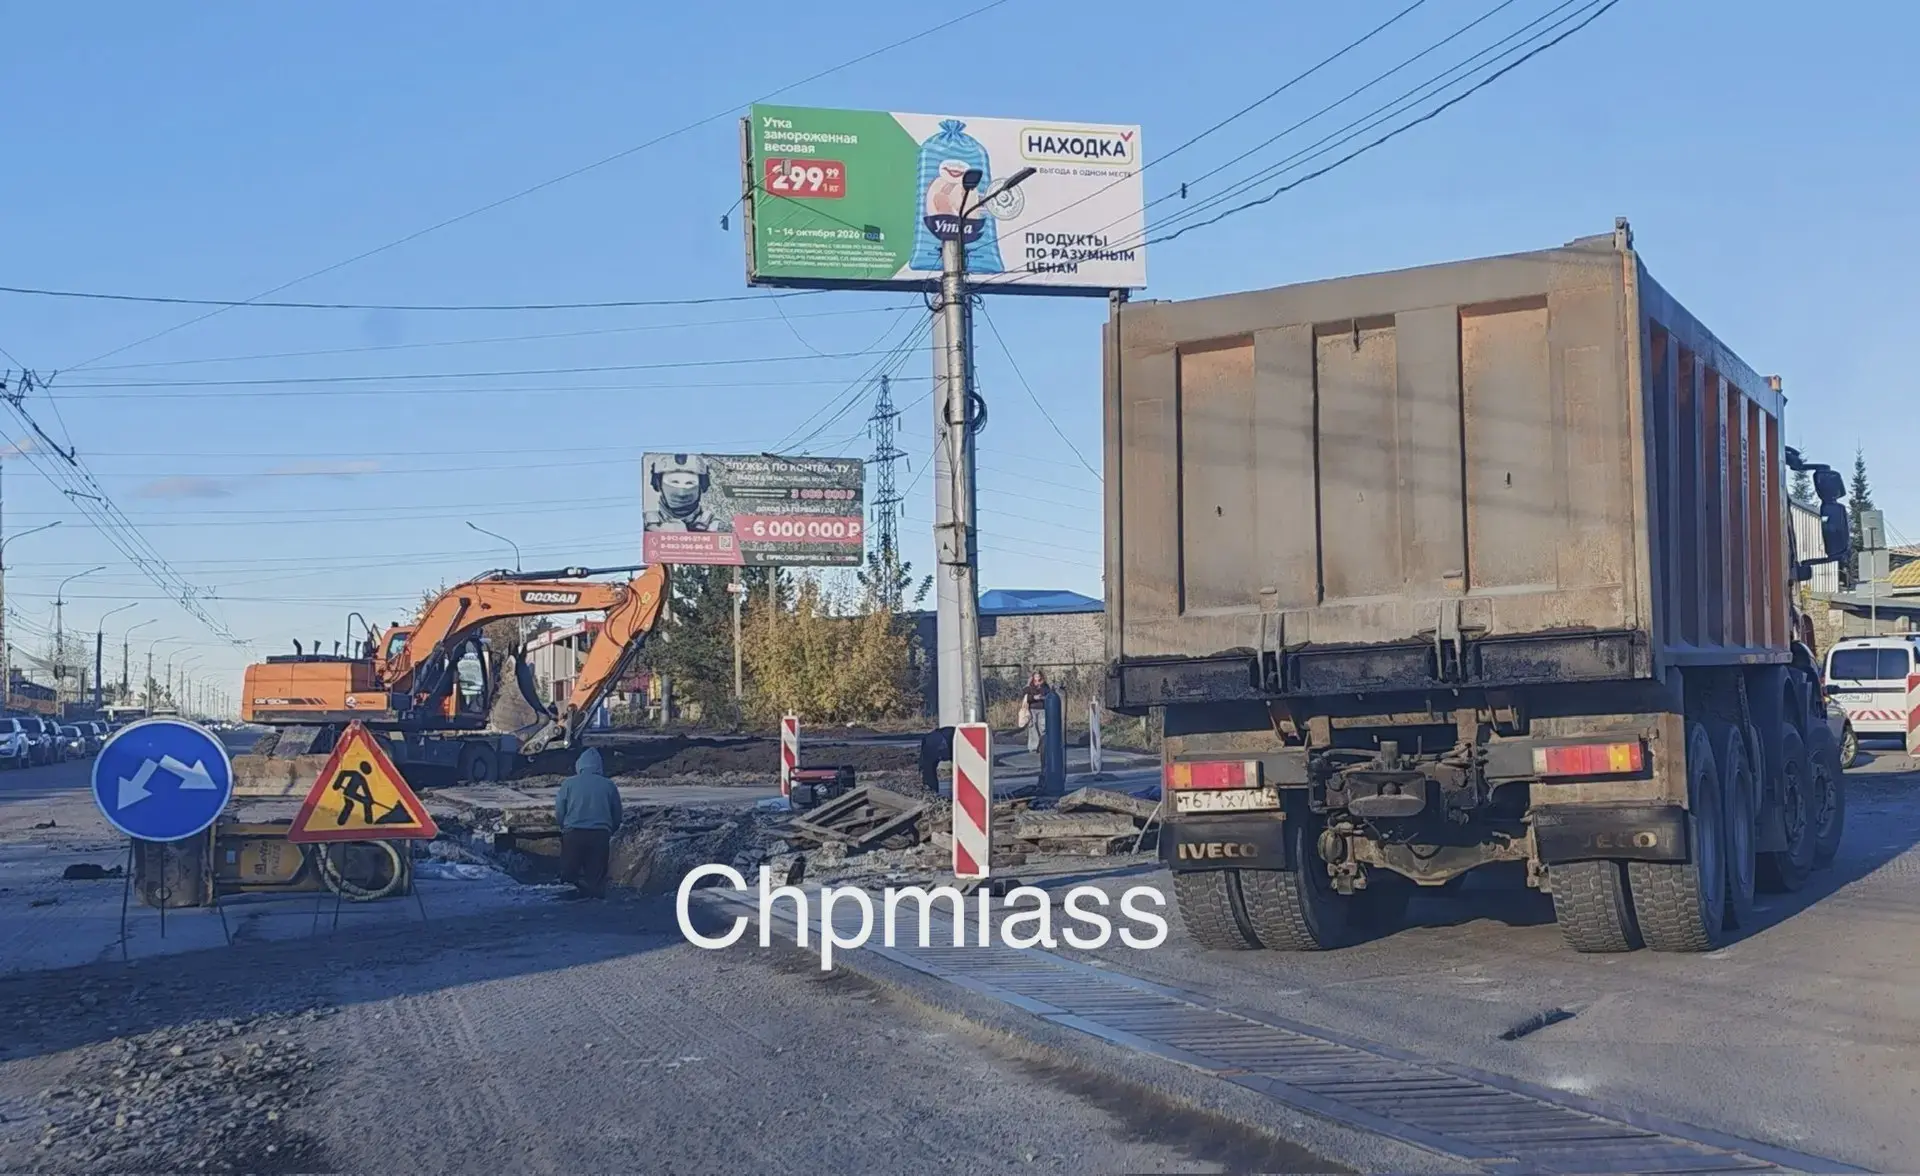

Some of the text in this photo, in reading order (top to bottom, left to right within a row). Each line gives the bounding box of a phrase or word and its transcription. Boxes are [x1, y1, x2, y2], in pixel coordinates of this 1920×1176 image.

[763, 117, 792, 128] Утка
[763, 130, 858, 144] замороженная
[764, 143, 815, 153] весовая
[1028, 135, 1126, 158] НАХОДКА
[772, 164, 824, 191] 299
[826, 168, 839, 178] 99
[1039, 167, 1071, 175] ВЫГОДА
[783, 228, 793, 236] 14
[795, 229, 836, 239] октября
[837, 230, 860, 239] 2026
[934, 220, 973, 234] Ута
[1025, 232, 1108, 247] ПРОДУКТЫ
[1026, 248, 1135, 261] ПО РАЗУМНЫМ
[1026, 261, 1078, 274] ЦЕНАМ
[772, 463, 788, 471] ПО
[768, 521, 805, 537] 000
[807, 521, 845, 538] 000
[525, 592, 578, 603] DOOSAN
[1178, 842, 1258, 859] IVECO
